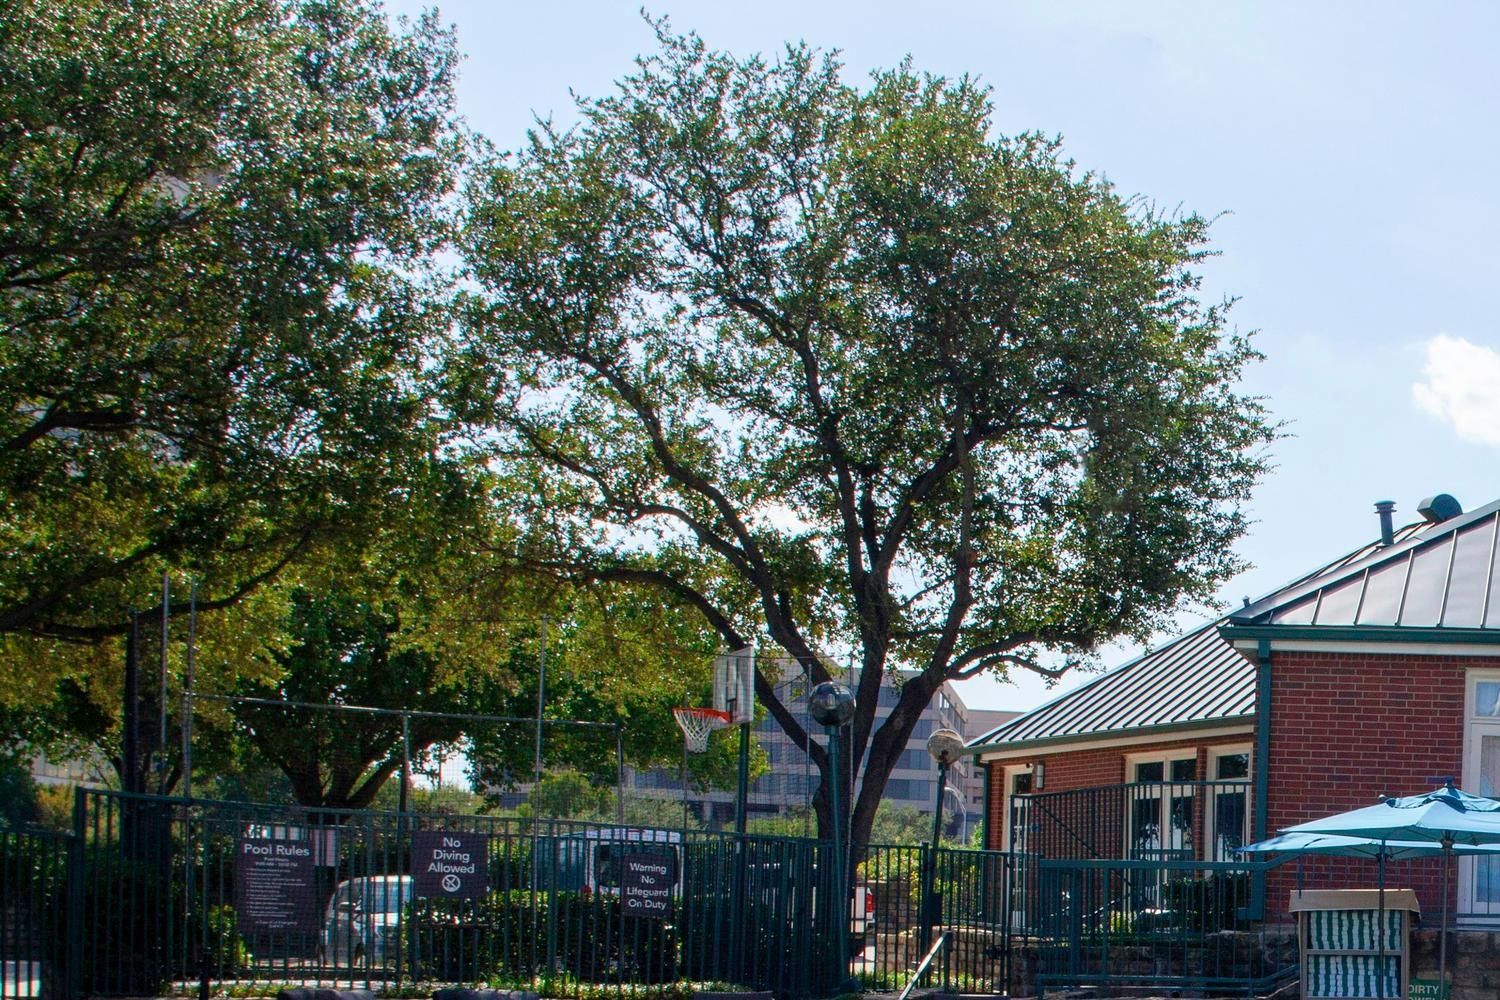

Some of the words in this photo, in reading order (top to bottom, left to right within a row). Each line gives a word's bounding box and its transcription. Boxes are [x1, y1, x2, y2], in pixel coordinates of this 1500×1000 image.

[443, 837, 462, 848] No
[244, 843, 273, 855] Pool
[276, 844, 310, 857] Rules
[433, 849, 470, 863] Diving
[427, 861, 475, 873] Allowed
[629, 862, 667, 875] Warning
[641, 875, 656, 884] No
[626, 886, 669, 898] Lifeguard
[628, 898, 642, 908] On
[644, 899, 667, 911] Duty
[1408, 984, 1440, 995] DIRTY
